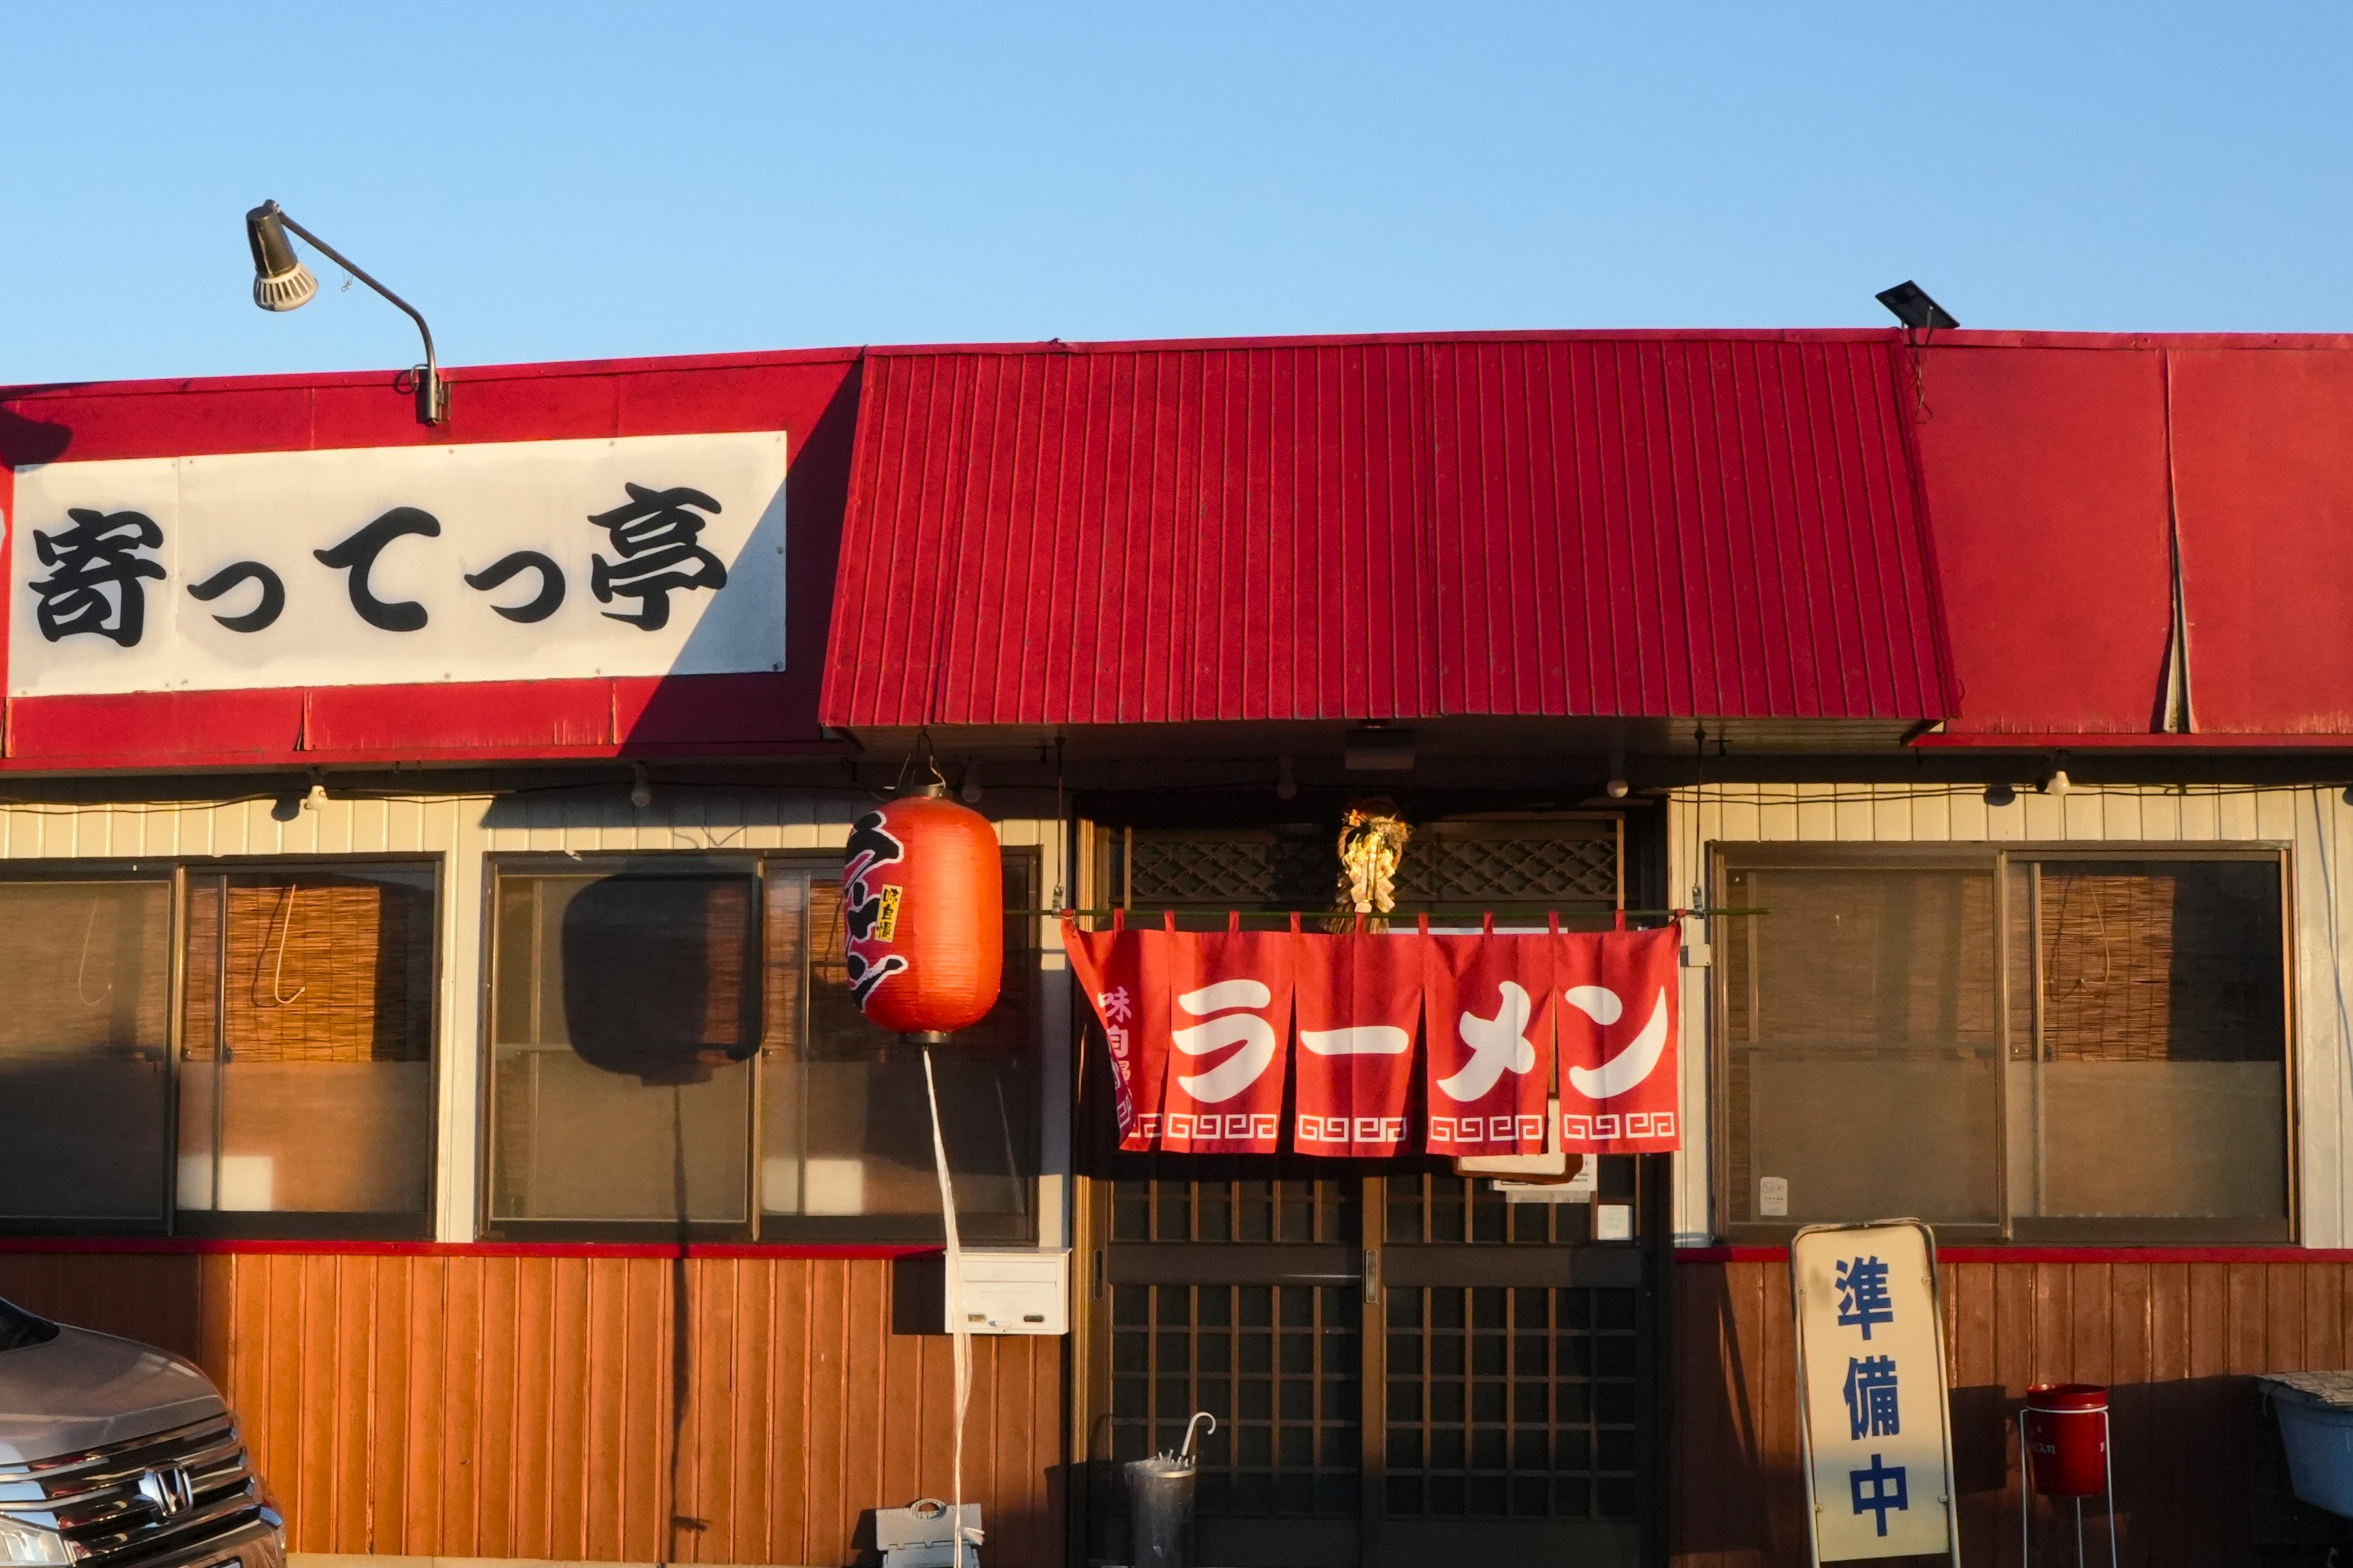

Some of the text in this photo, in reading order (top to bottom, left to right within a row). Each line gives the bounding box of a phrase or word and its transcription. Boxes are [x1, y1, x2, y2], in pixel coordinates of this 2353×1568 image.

[29, 482, 727, 647] 寄ってっ亭
[876, 888, 899, 940] 味自慢
[1172, 979, 1668, 1103] ラーメン
[1835, 1255, 1908, 1537] 準備中
